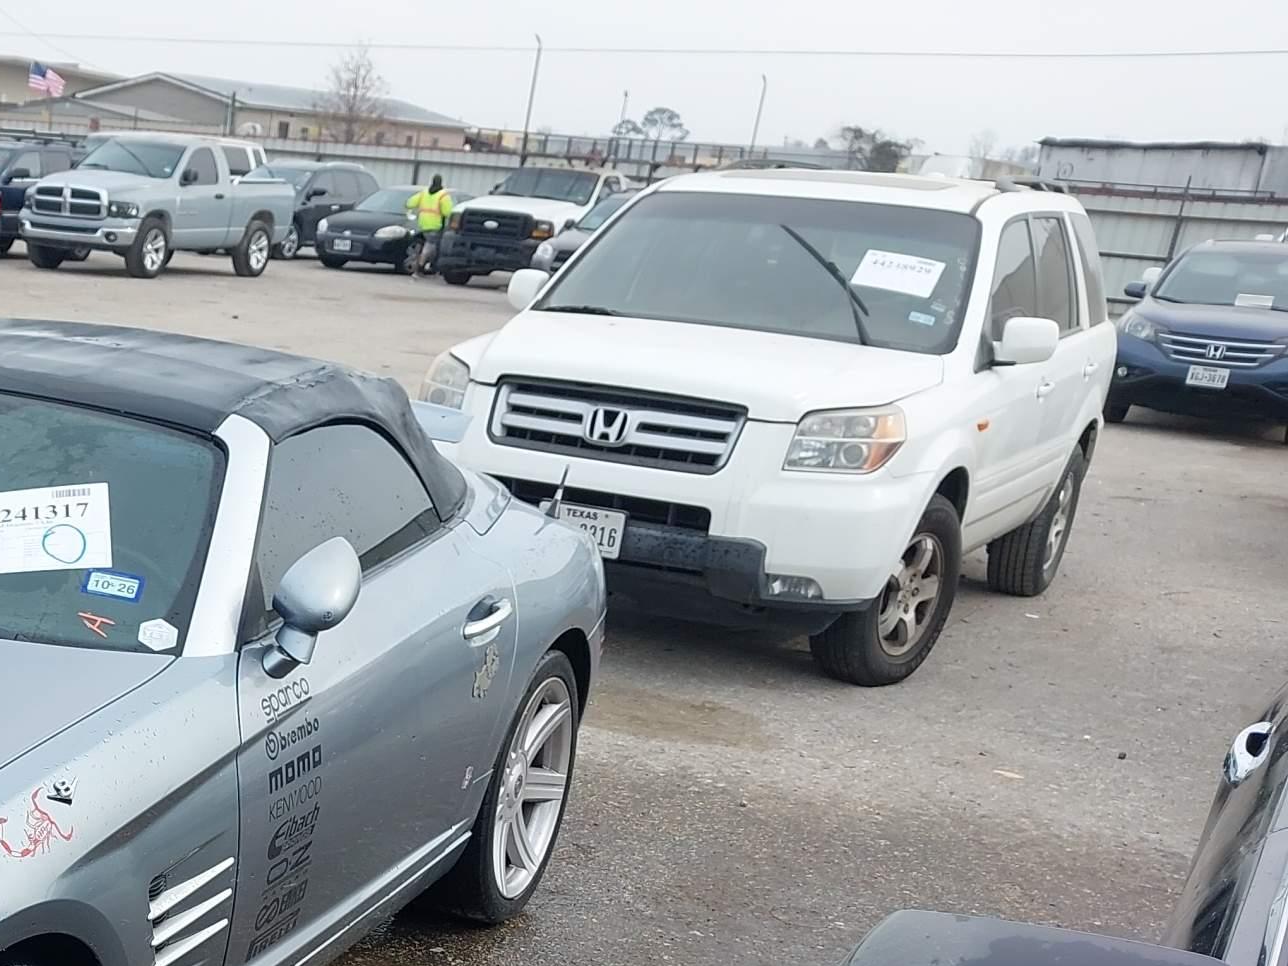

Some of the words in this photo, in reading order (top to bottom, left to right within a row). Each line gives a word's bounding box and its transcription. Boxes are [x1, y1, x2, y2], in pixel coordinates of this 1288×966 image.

[566, 508, 599, 521] TEXAS
[261, 677, 310, 720] sparco
[279, 717, 320, 751] brembo
[268, 776, 323, 822] KENWOOD
[267, 802, 321, 861] Eibach
